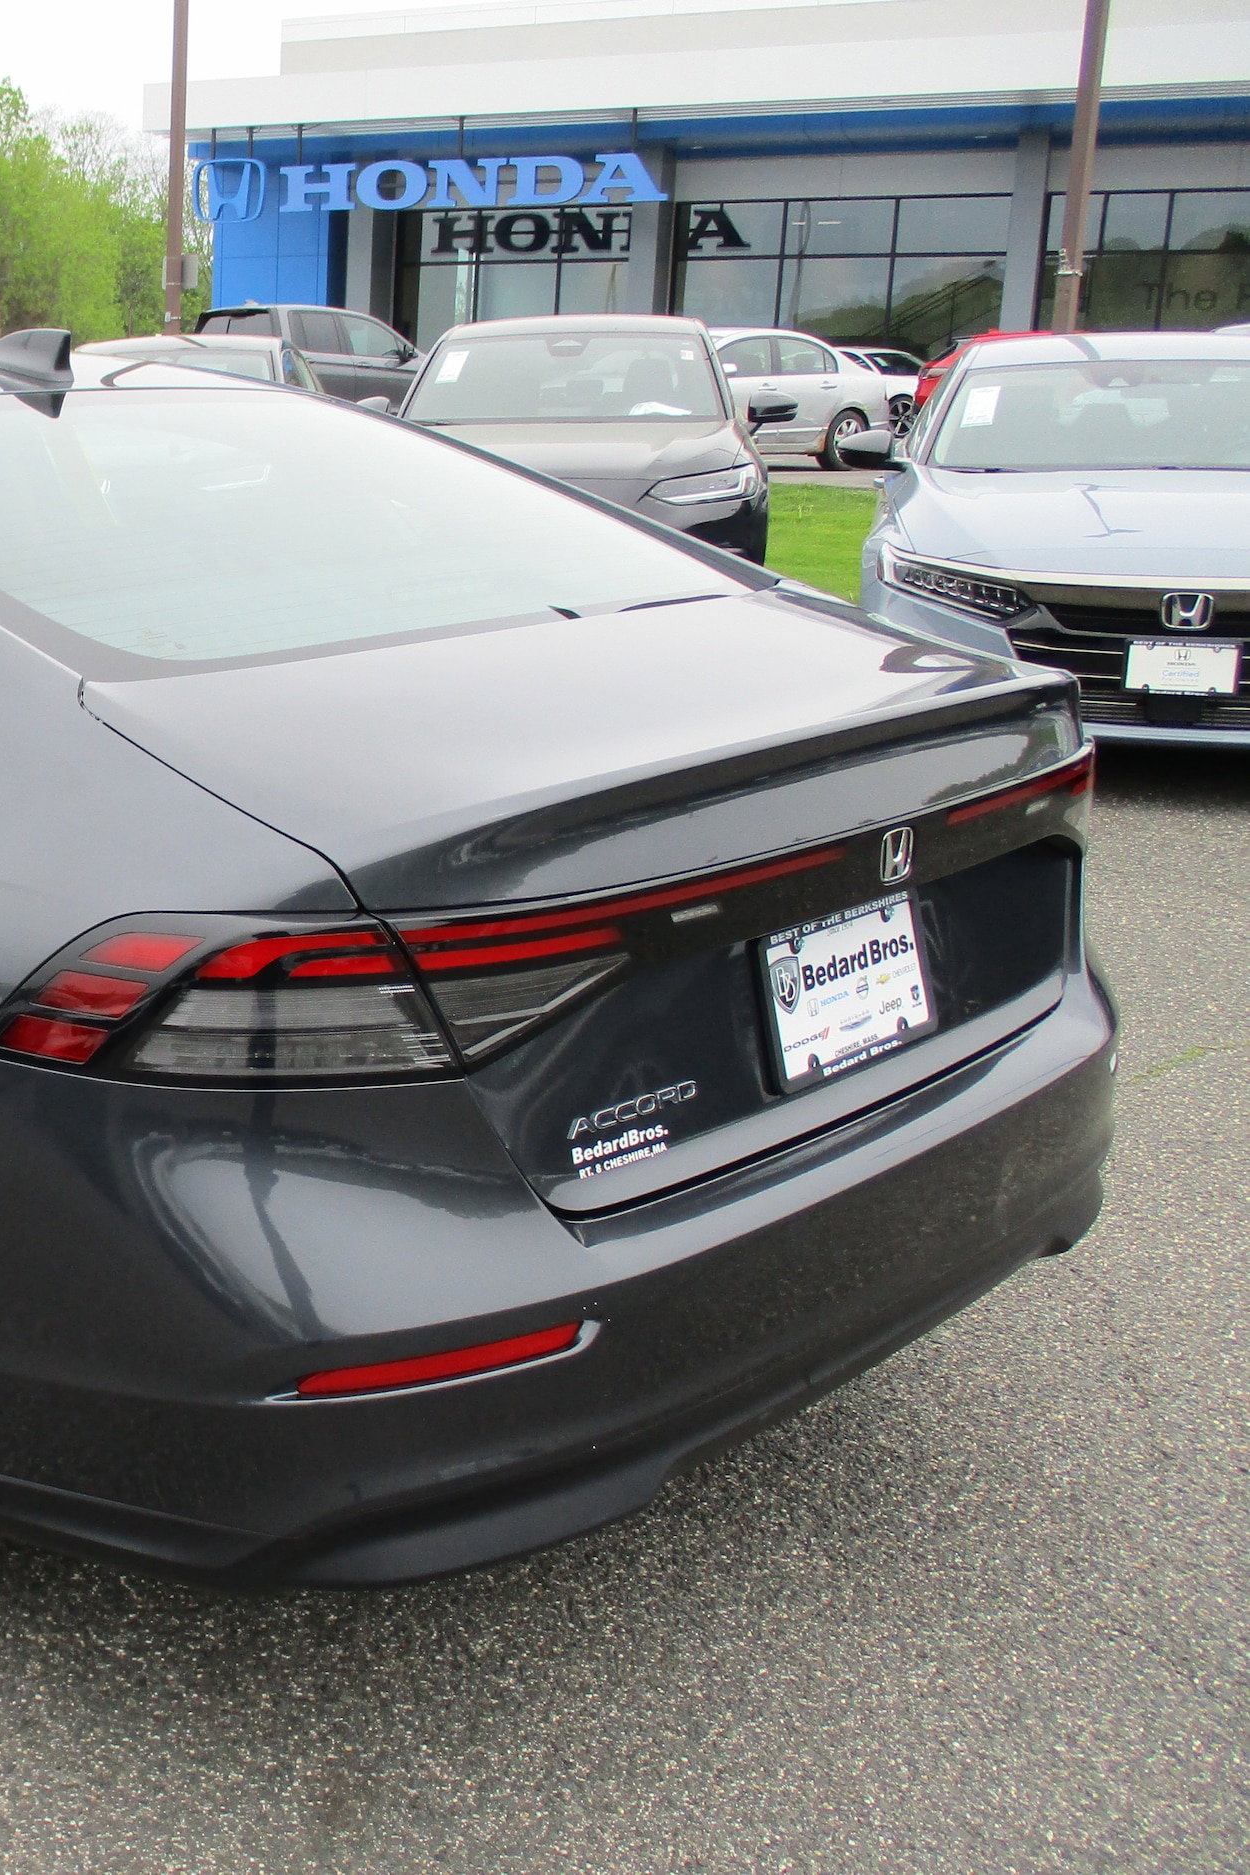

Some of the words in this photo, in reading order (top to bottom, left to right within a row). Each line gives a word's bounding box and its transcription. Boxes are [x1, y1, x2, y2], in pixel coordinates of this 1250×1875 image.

[280, 153, 667, 212] HONDA
[431, 208, 751, 253] HONA
[1135, 282, 1217, 310] The
[1162, 669, 1199, 678] Certified
[770, 927, 799, 945] BEST
[802, 922, 818, 934] OF
[820, 913, 842, 928] THE
[845, 891, 908, 920] BERKSHIRES
[802, 944, 868, 991] Bedard
[870, 934, 914, 965] Bros.
[820, 990, 849, 1007] HONDA
[879, 997, 902, 1015] Jeep
[784, 1031, 825, 1053] DODGE
[823, 1049, 867, 1077] Bedard
[870, 1039, 903, 1057] Bros.
[567, 1080, 697, 1139] ACCORD
[579, 1165, 595, 1179] RT.
[595, 1163, 602, 1174] 8
